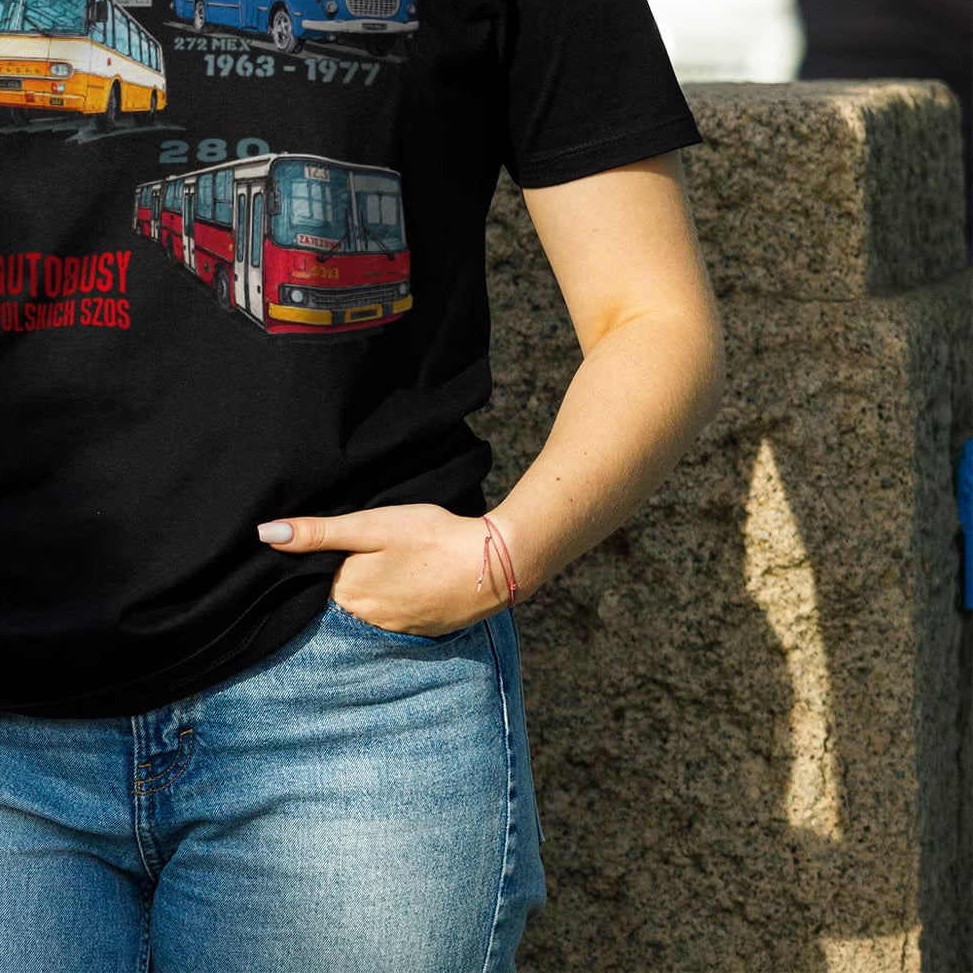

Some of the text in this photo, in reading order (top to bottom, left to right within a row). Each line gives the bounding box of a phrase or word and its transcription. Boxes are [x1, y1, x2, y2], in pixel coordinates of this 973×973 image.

[173, 37, 251, 52] 272 MEX
[204, 54, 275, 77] 1963
[304, 57, 381, 86] 1977
[158, 137, 271, 164] 280
[80, 297, 132, 331] SZOS
